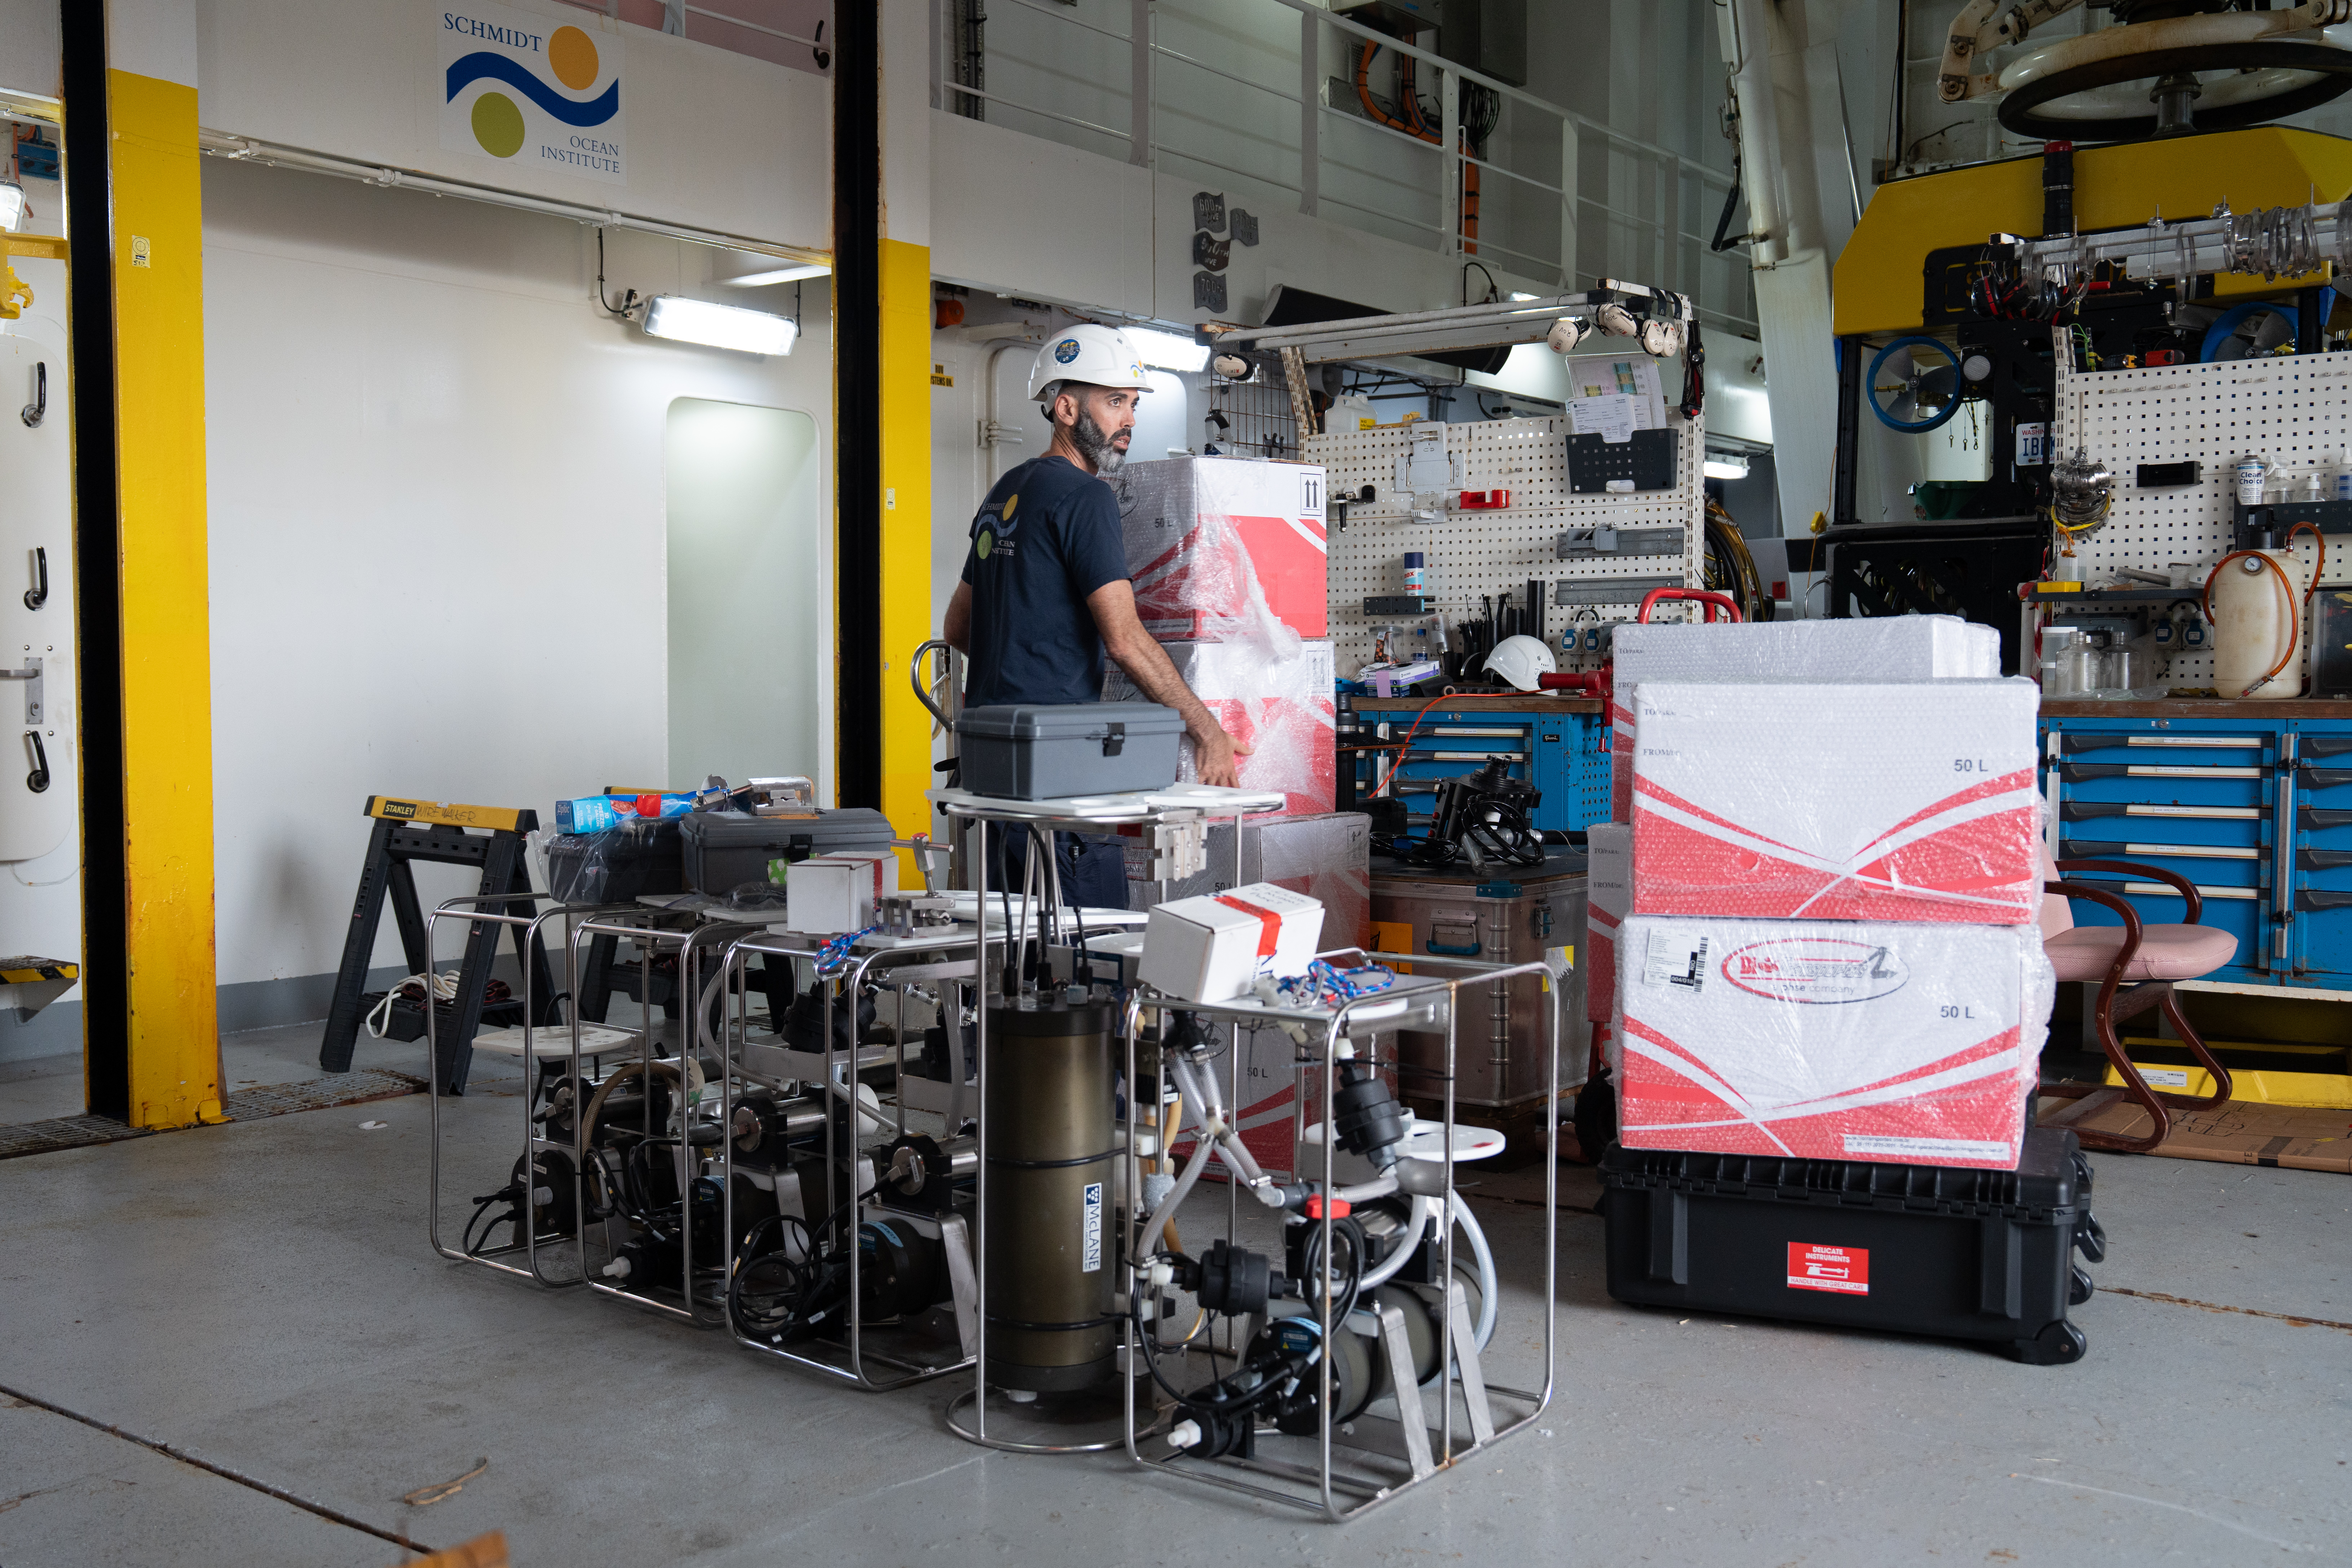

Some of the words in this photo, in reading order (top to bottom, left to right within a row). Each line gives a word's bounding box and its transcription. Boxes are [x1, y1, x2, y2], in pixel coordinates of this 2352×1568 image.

[444, 13, 542, 52] SCHMIDT
[570, 136, 619, 157] OCEAN
[541, 145, 620, 173] INSTITUTE
[1559, 327, 1571, 337] ROV
[1155, 518, 1164, 528] 50
[1954, 759, 1972, 772] 50
[1979, 759, 1988, 772] L
[385, 804, 414, 816] STANLEY
[417, 805, 440, 818] WIRE
[442, 808, 476, 823] WALKER
[557, 804, 570, 816] Ziploc
[1215, 882, 1225, 892] 50
[1809, 985, 1854, 994] company
[1940, 1006, 1958, 1018] 50
[1965, 1006, 1974, 1019] L
[1247, 1066, 1258, 1077] 50
[1262, 1068, 1268, 1078] L
[1088, 1205, 1099, 1269] McLANE
[1812, 1246, 1843, 1255] DELICATE
[1805, 1253, 1850, 1263] INSTRUMENTS
